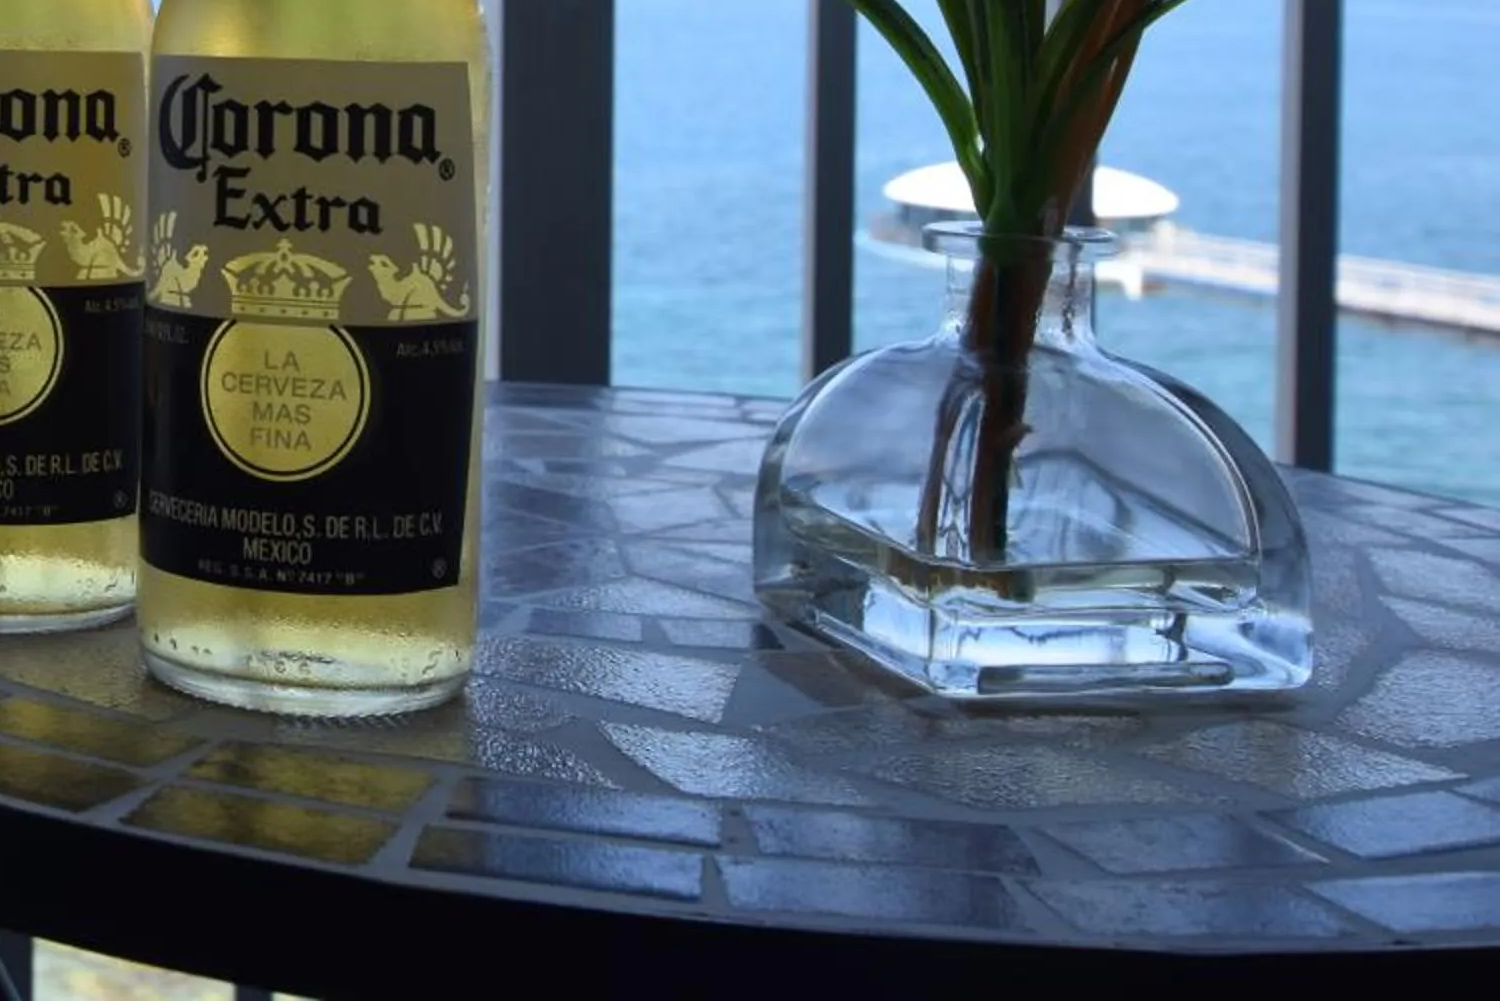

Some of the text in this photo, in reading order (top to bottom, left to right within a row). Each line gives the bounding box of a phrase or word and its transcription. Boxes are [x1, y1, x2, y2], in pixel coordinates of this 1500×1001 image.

[159, 73, 441, 183] Corona
[212, 165, 383, 235] Extra
[264, 351, 300, 372] LA
[221, 372, 347, 401] CERVEZA
[251, 401, 312, 426] MAS
[250, 427, 312, 451] FINA
[25, 453, 48, 476] DE
[325, 515, 350, 540] DE
[393, 514, 416, 540] DE
[242, 536, 313, 566] MEXICO
